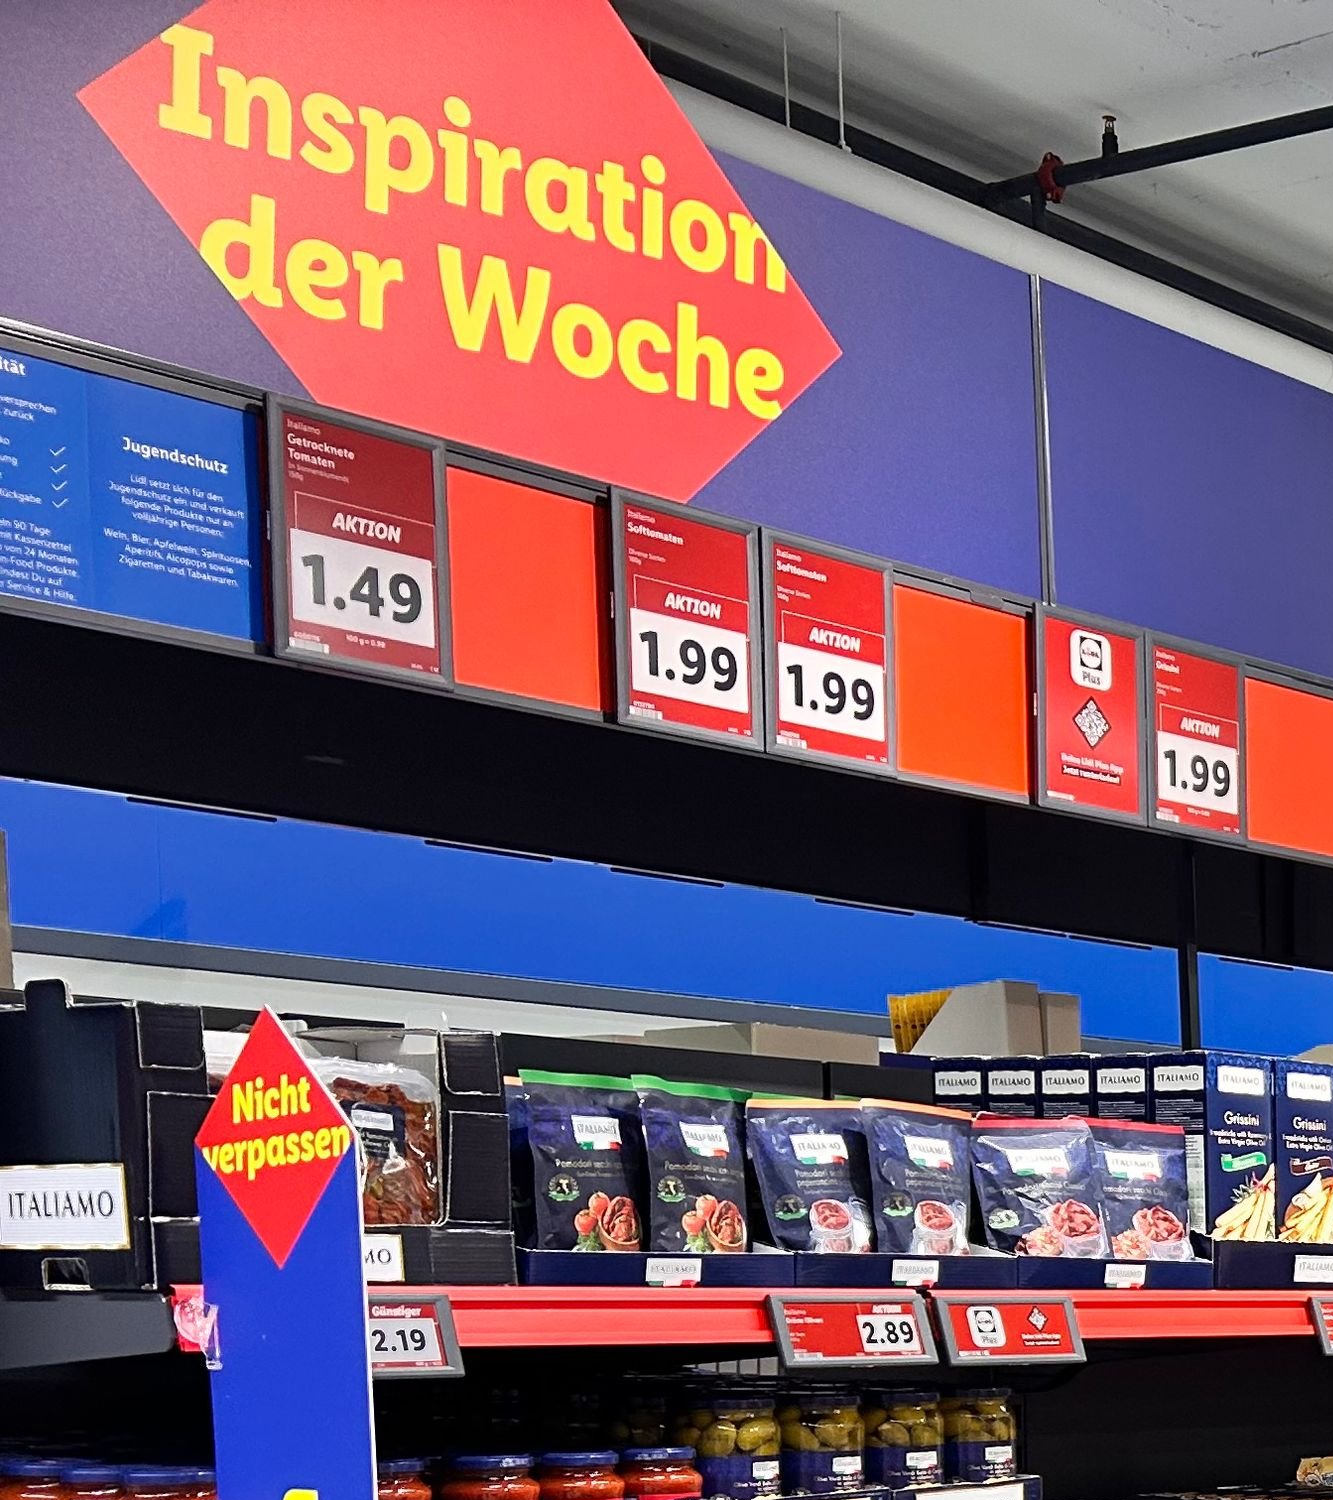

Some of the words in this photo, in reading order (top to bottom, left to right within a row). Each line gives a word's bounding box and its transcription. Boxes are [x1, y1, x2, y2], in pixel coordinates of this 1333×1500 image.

[158, 25, 787, 293] Inspiration
[200, 195, 404, 330] der
[436, 243, 785, 422] Woche
[122, 436, 229, 475] Jugendschutz
[288, 433, 356, 461] Getrocknete
[288, 448, 336, 470] Tomaten
[109, 481, 172, 502] Jugendschutz
[190, 499, 207, 511] und
[209, 504, 245, 519] verkauft
[149, 478, 170, 490] setzt
[172, 483, 190, 495] sich
[192, 487, 205, 499] für
[207, 491, 224, 502] den
[121, 496, 162, 513] folgende
[164, 504, 203, 521] Produkte
[206, 516, 221, 526] nur
[133, 511, 179, 529] volljährige
[332, 512, 402, 544] AKTION
[627, 521, 684, 546] Softtomaten
[119, 554, 165, 572] Zigaretten
[167, 564, 185, 576] und
[187, 568, 239, 587] Tabakwaren.
[166, 551, 207, 570] Alcopops
[209, 562, 234, 574] sowie
[776, 560, 828, 584] Softtomaten
[302, 553, 423, 624] 1.49
[665, 592, 721, 620] AKTION
[809, 626, 861, 652] AKTION
[639, 630, 739, 691] 1.99
[787, 664, 875, 721] 1.99
[1180, 716, 1221, 738] AKTION
[1164, 749, 1231, 797] 1.99
[1100, 1074, 1142, 1087] ITALIAMO
[232, 1074, 311, 1124] Nicht
[1223, 1111, 1260, 1127] Grissini
[203, 1124, 351, 1181] verpassen
[6, 1189, 115, 1219] ITALIAMO
[373, 1329, 427, 1352] 2.19
[862, 1319, 914, 1344] 2.89
